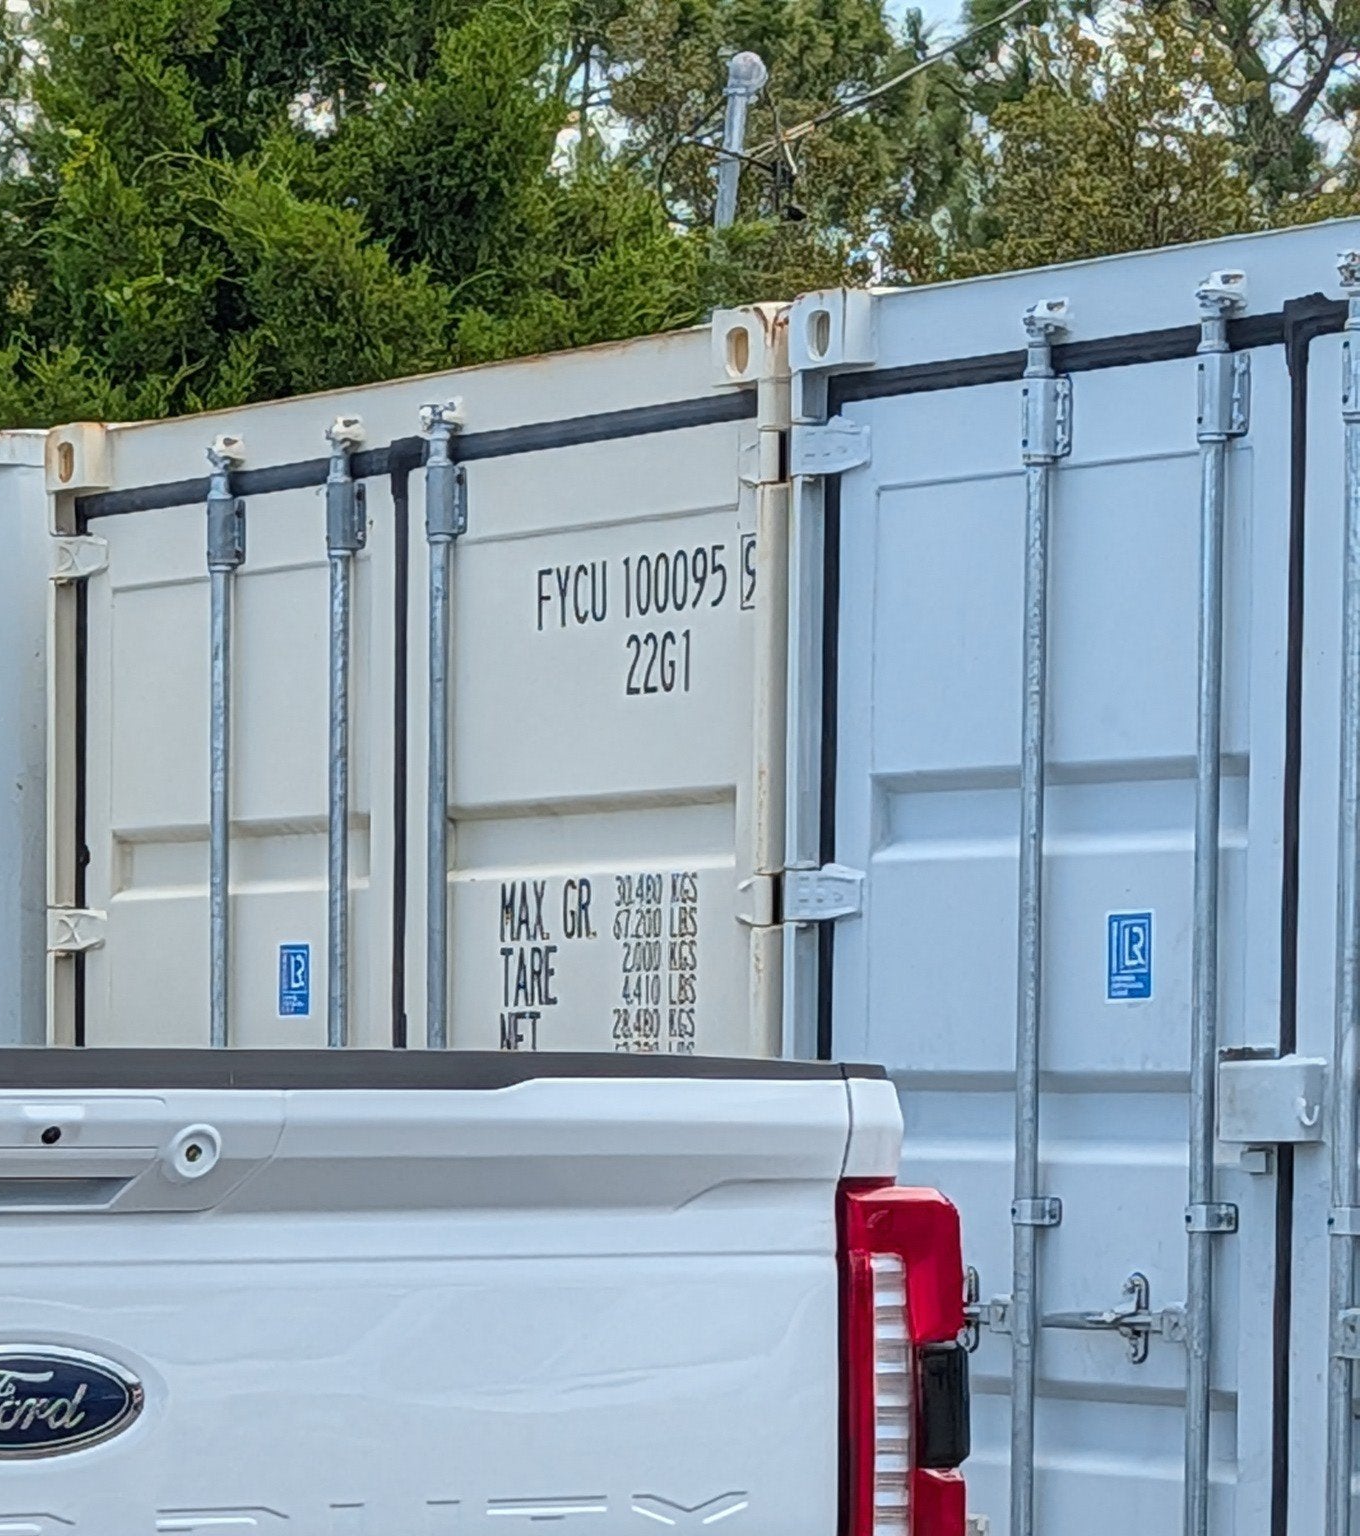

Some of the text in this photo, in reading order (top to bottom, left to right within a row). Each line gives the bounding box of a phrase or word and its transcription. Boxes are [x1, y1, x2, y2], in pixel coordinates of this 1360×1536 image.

[537, 560, 608, 631] FYCU
[622, 544, 728, 618] 100095
[626, 629, 691, 695] 22G1
[499, 880, 550, 942] MAX.
[563, 878, 597, 940] GR.
[669, 906, 698, 938] LBS
[499, 945, 558, 1007] TARE
[668, 940, 698, 971] KGS
[668, 974, 697, 1006] LBS
